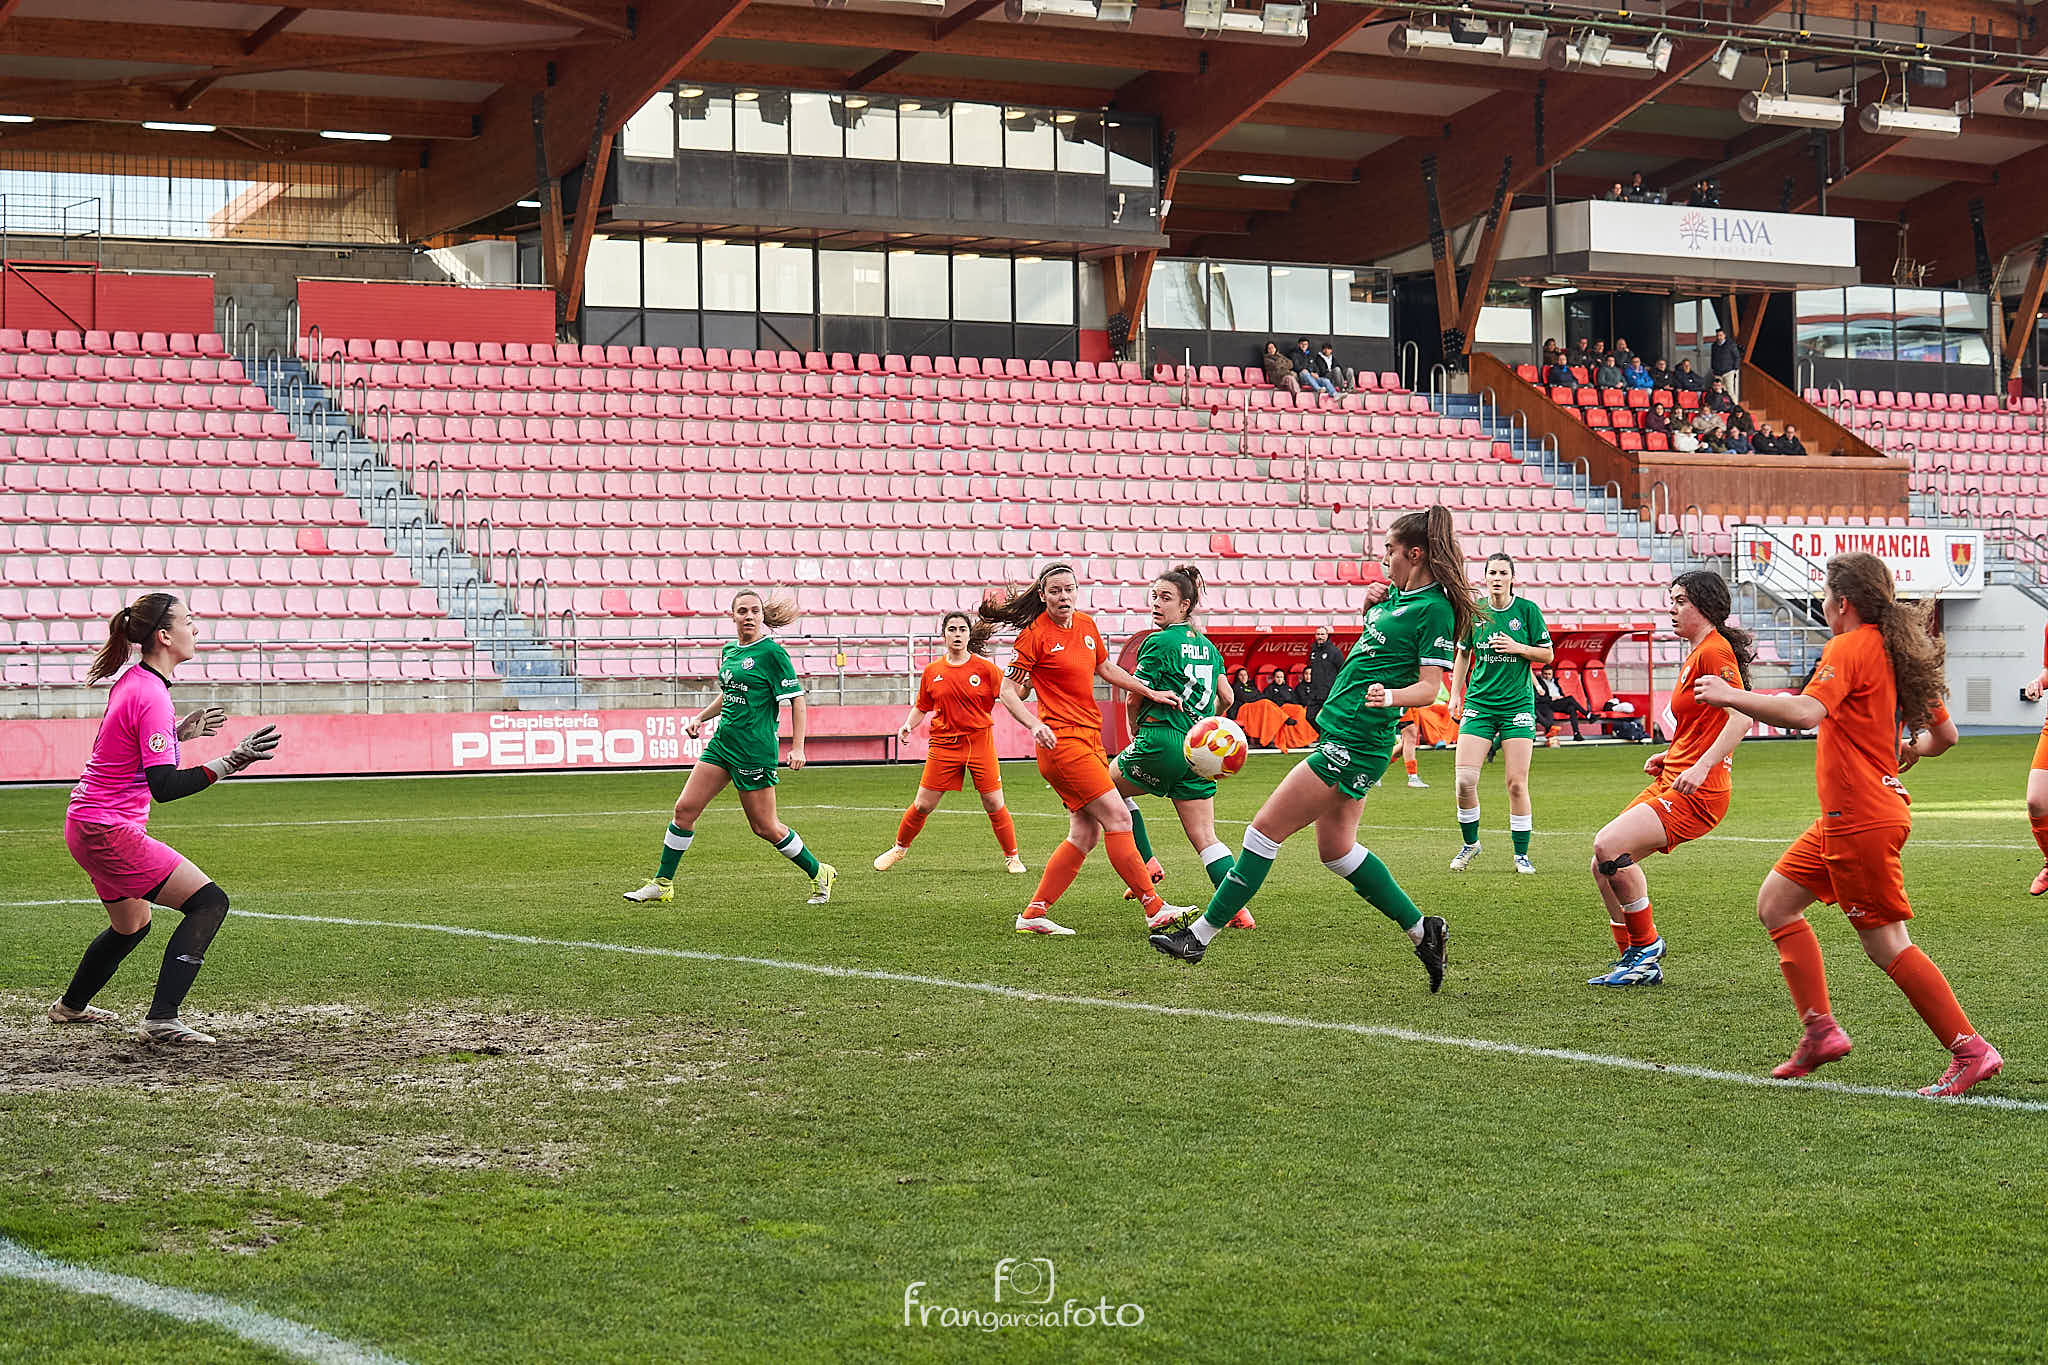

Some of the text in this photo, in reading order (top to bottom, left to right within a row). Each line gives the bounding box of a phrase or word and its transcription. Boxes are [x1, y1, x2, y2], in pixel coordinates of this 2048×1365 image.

[1711, 216, 1773, 246] HAYA
[1792, 532, 1931, 559] C.D. NUMANCIA
[1810, 568, 1916, 582] DE A.D.
[1180, 643, 1210, 661] PAULA
[1257, 641, 1309, 653] AVATEL
[1182, 663, 1214, 711] 17
[489, 713, 600, 731] Chapistería
[646, 716, 676, 737] 975
[451, 729, 645, 767] PEDRO
[649, 738, 679, 759] 699
